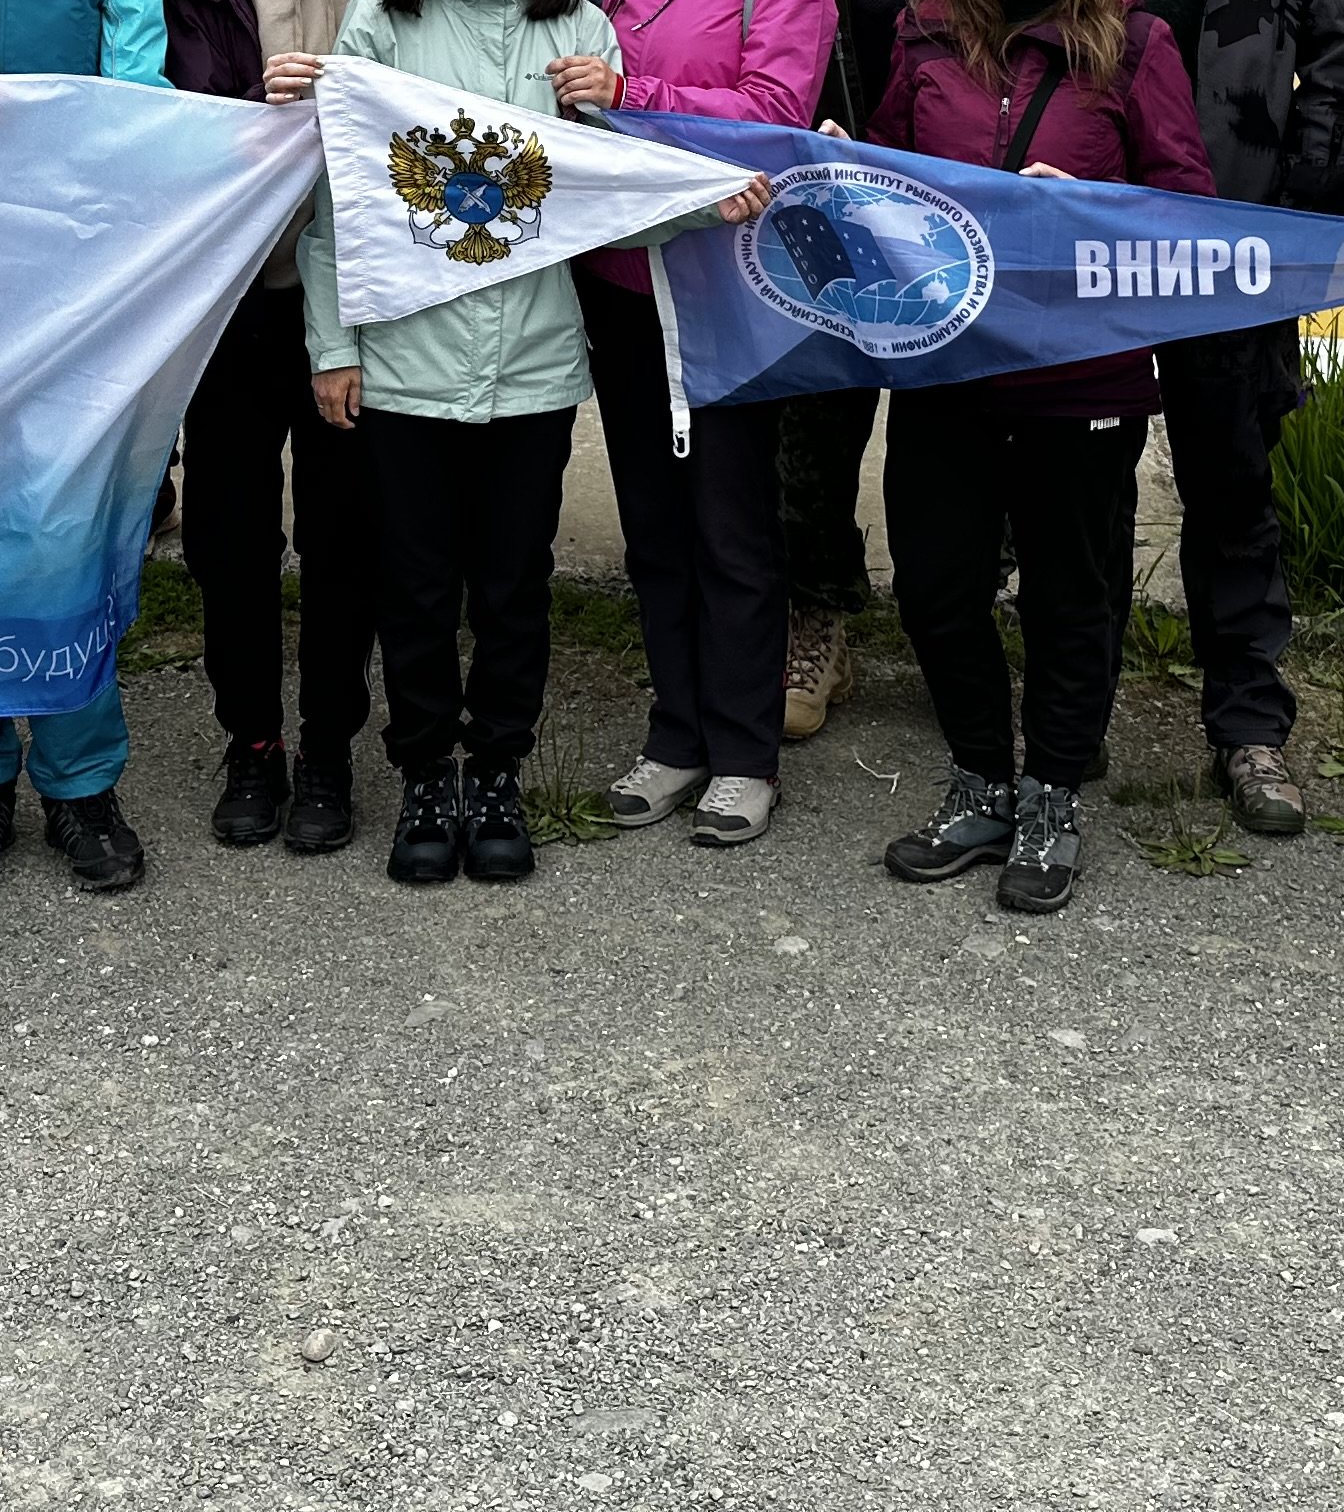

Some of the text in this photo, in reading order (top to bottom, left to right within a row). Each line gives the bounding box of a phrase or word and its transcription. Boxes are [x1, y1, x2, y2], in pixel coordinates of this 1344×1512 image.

[835, 169, 903, 190] ИНСТИТУТ
[905, 183, 963, 222] РЫБНОГО
[960, 220, 990, 297] ХОЗЯЙСТВА
[1075, 236, 1271, 298] ВНИРО
[966, 297, 979, 310] И
[891, 308, 971, 353] ОКЕАНОГРАФИИ
